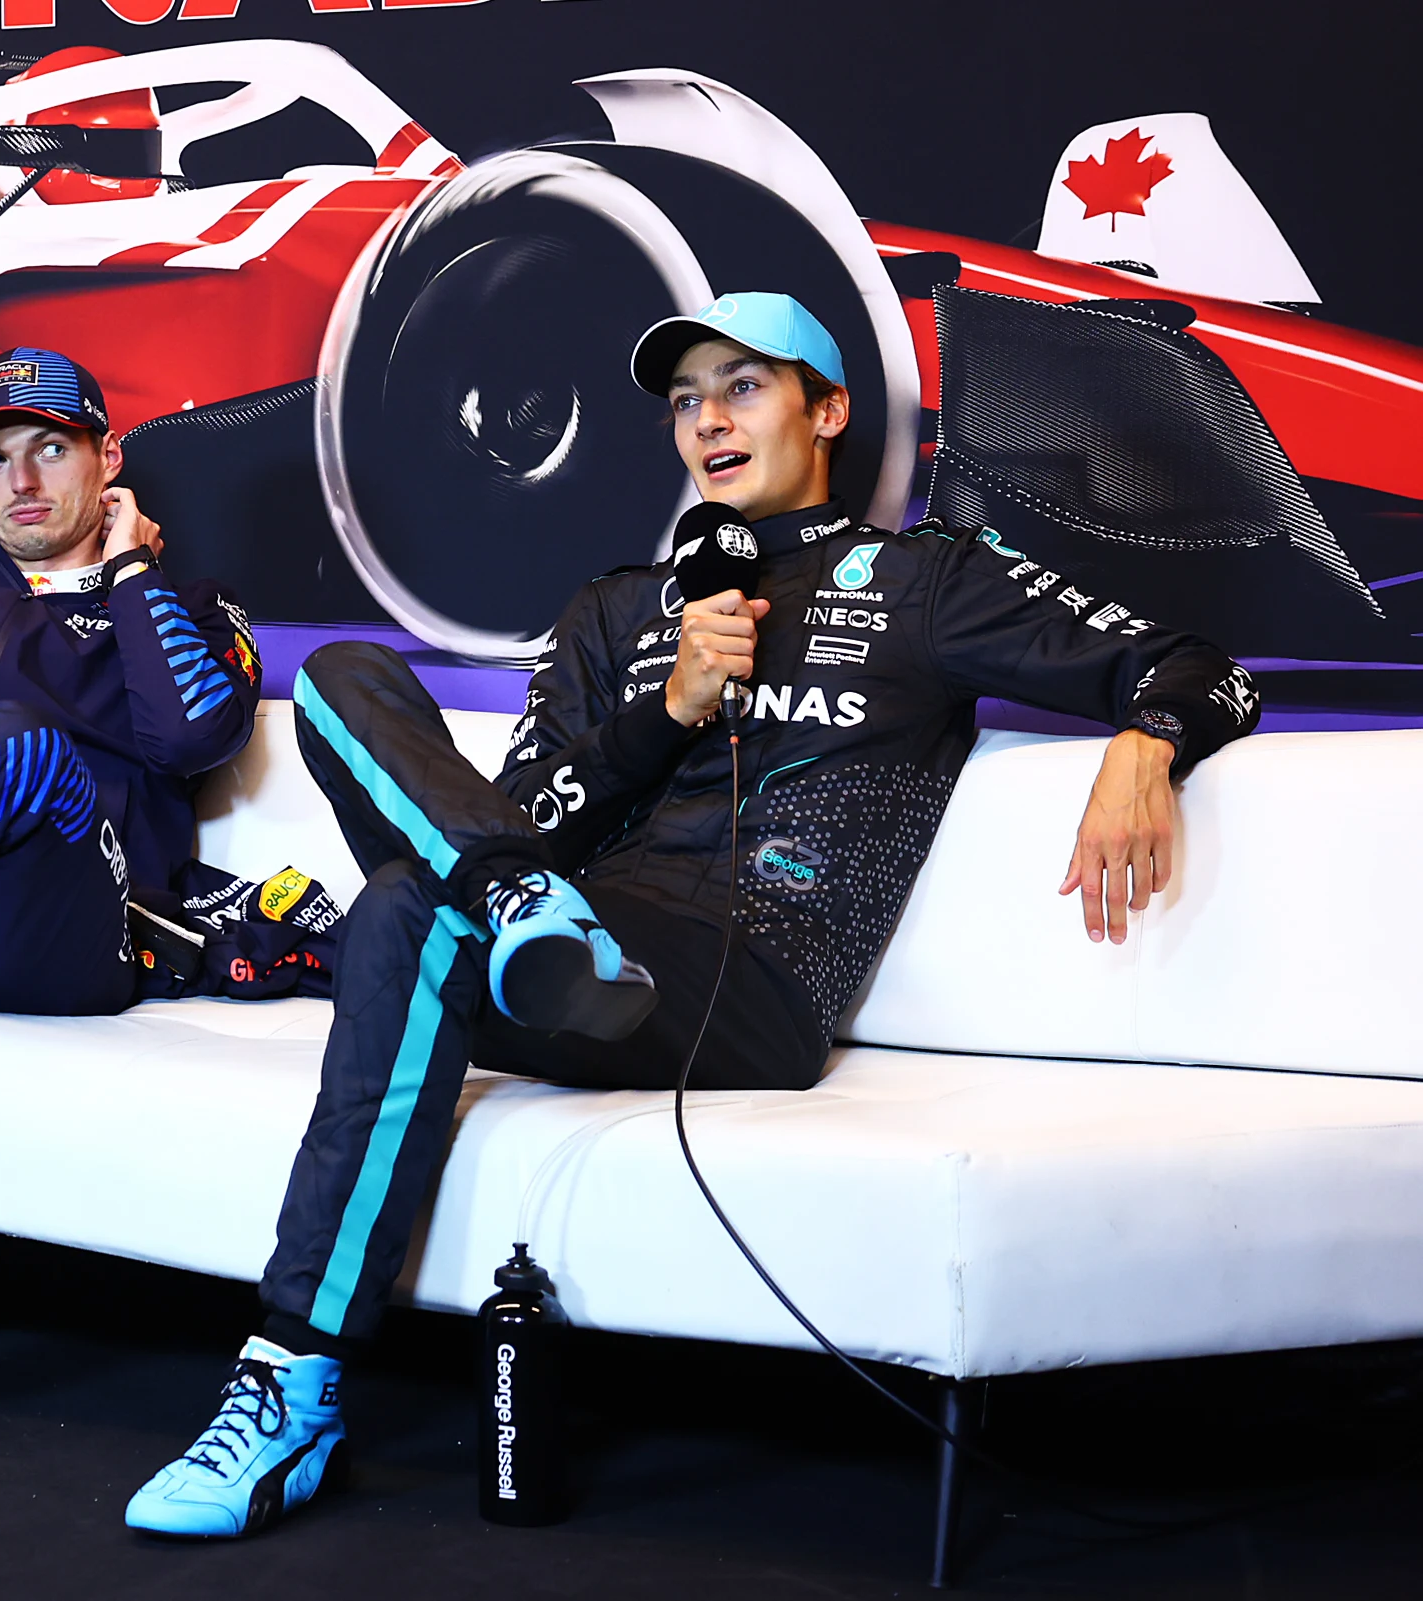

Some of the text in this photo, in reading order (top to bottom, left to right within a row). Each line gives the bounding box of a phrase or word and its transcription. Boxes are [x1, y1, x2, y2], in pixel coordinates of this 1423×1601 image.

[815, 589, 884, 602] PETRONAS
[803, 606, 889, 632] INEOS
[804, 656, 842, 666] Enterprise
[761, 848, 815, 880] George
[265, 871, 306, 911] RAUCH
[494, 1343, 517, 1500] George Russell
